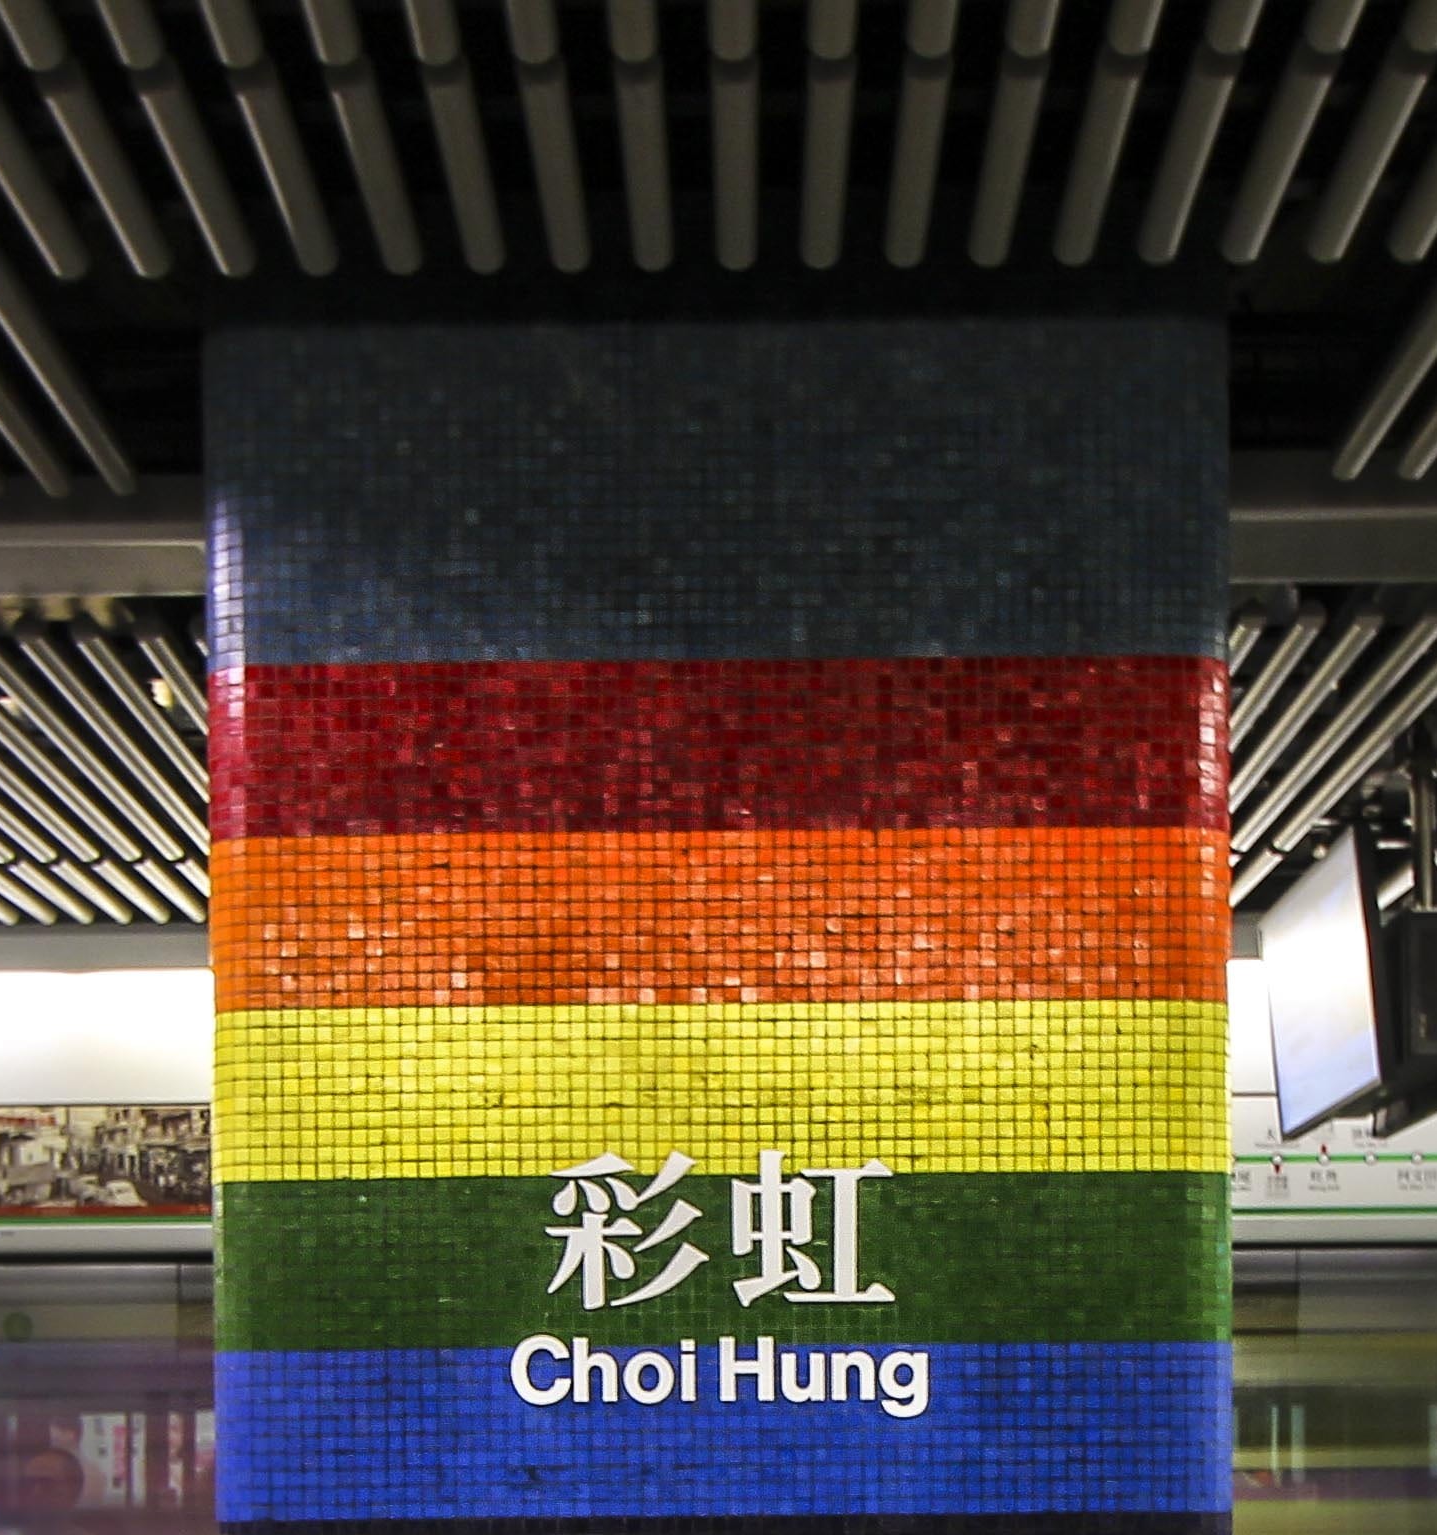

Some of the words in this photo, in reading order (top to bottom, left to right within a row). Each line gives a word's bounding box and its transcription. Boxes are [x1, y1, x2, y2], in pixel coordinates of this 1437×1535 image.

[544, 1149, 896, 1310] 彩虹
[510, 1334, 698, 1406] Choi
[718, 1336, 930, 1418] Hung
